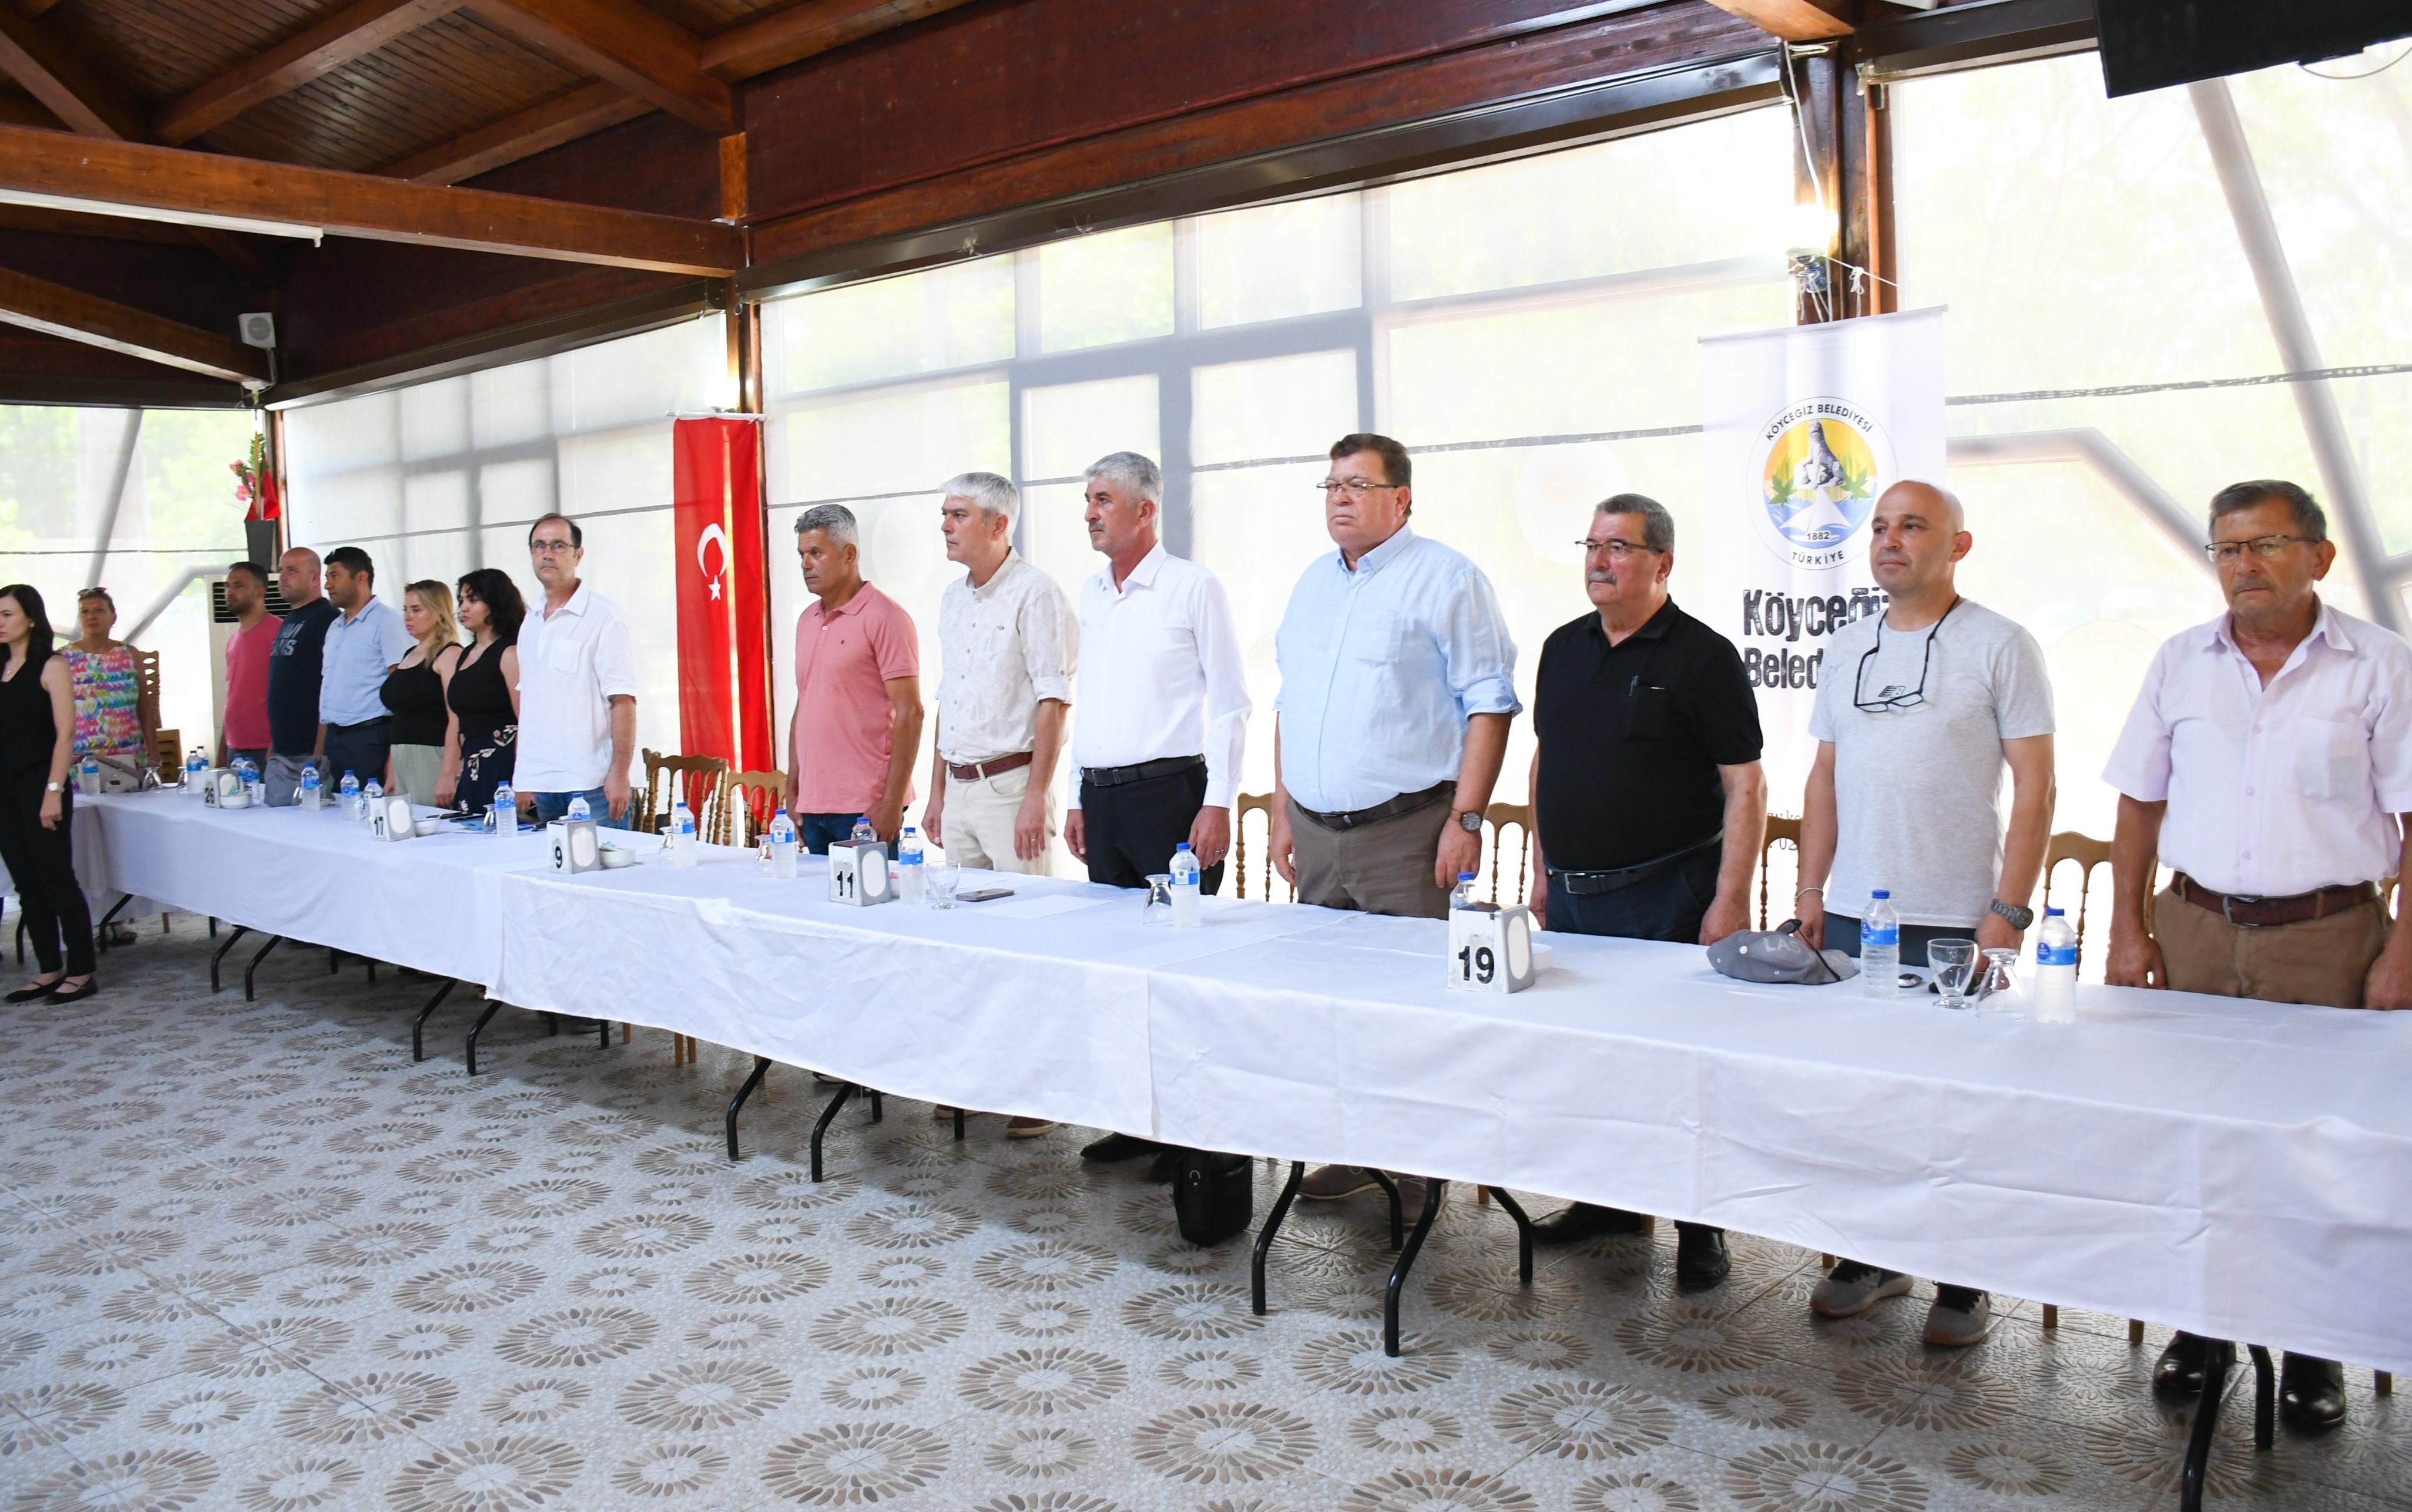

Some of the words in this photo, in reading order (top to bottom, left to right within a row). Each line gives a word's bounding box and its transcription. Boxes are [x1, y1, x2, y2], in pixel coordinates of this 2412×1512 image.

[1817, 404, 1873, 432] BELEDİYESİ
[1807, 532, 1830, 540] 1882
[1792, 550, 1844, 565] TÜRKİYE
[374, 816, 384, 835] 17
[555, 845, 563, 869] 9
[837, 871, 854, 899] 11
[1764, 939, 1802, 954] LAS
[1458, 945, 1495, 985] 19
